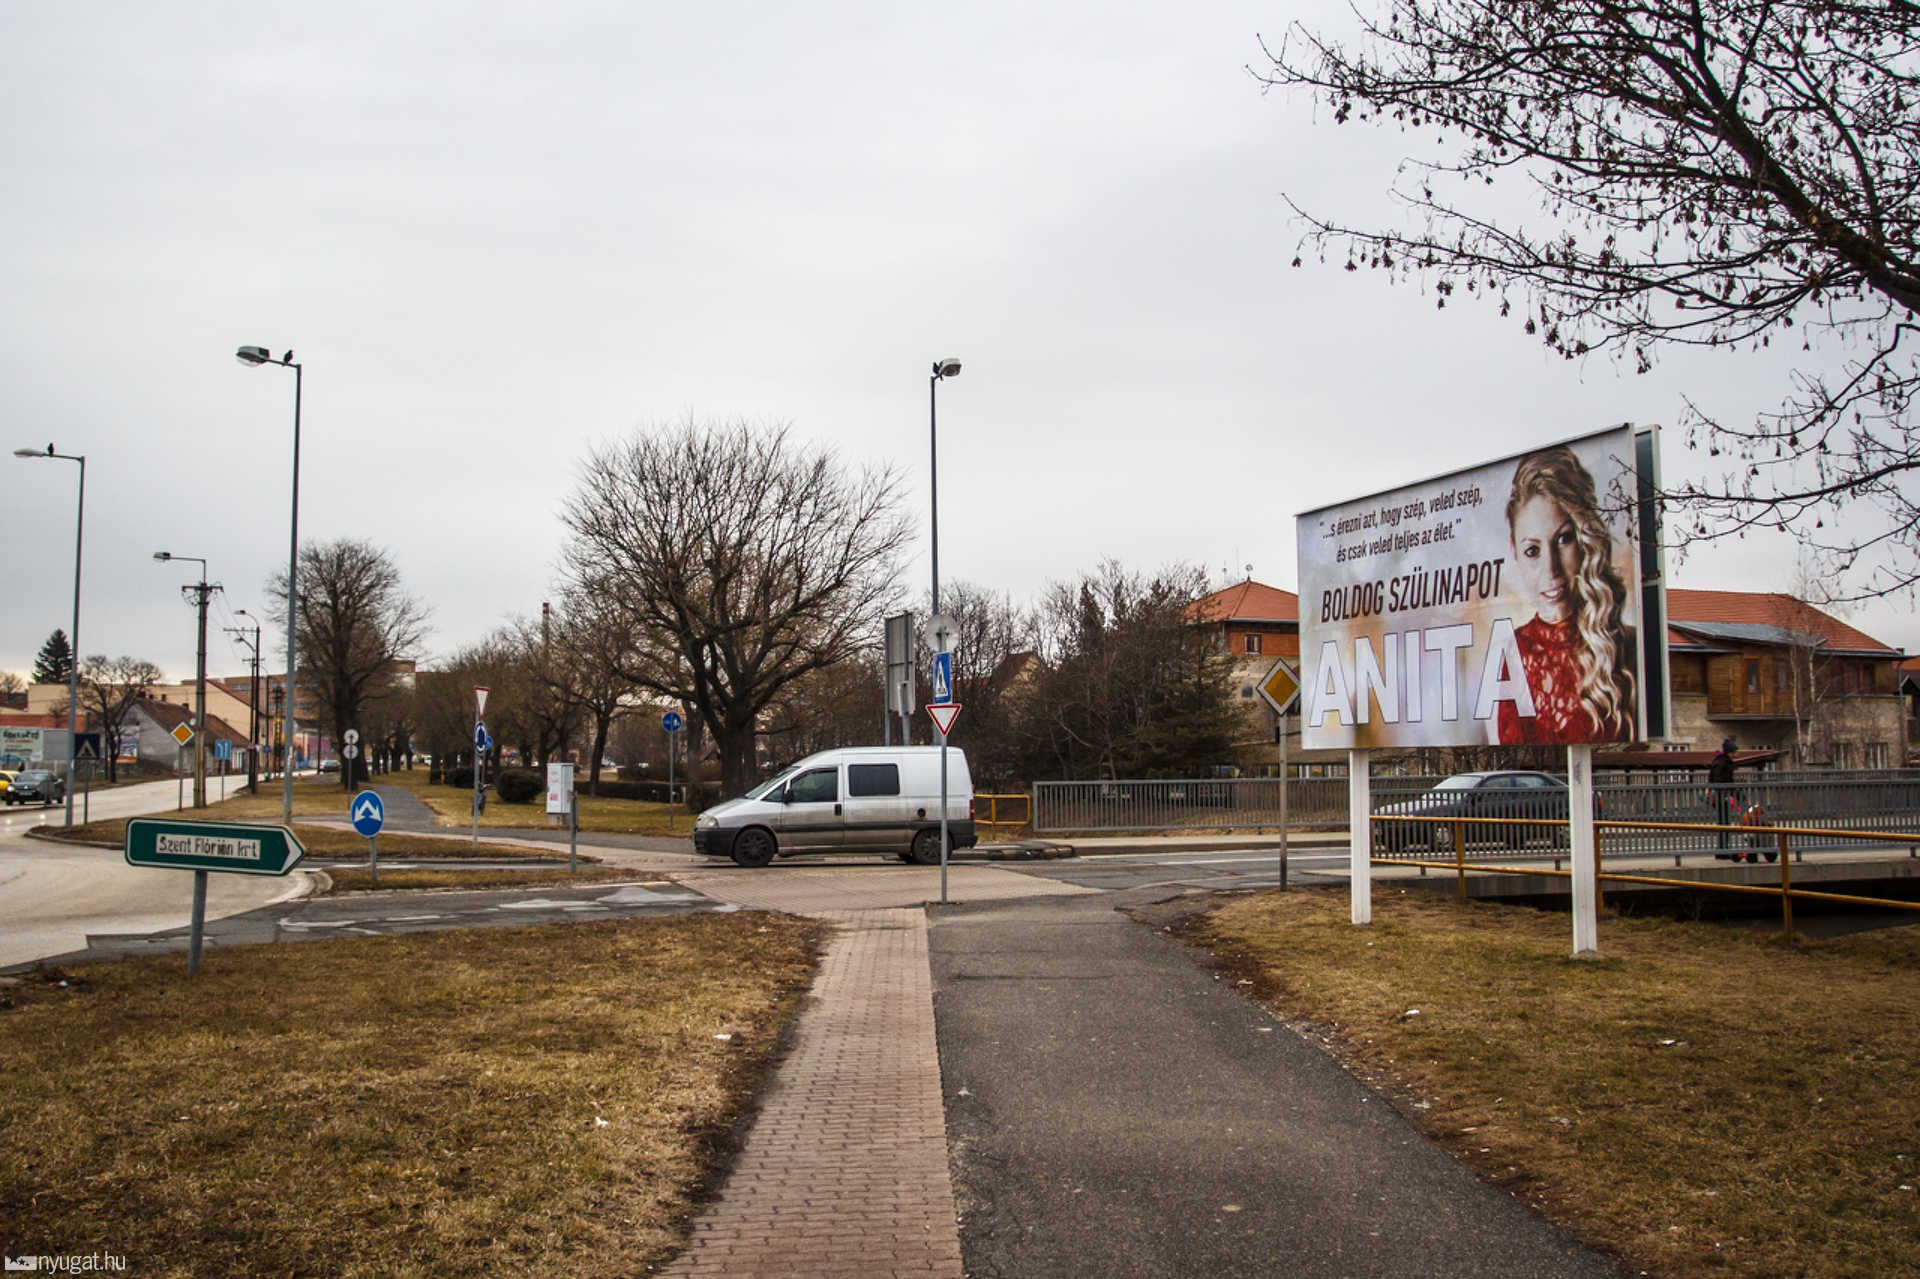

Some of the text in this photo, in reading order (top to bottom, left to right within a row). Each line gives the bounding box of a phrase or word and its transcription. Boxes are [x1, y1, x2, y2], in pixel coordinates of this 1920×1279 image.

[1337, 512, 1362, 536] érezni
[1363, 510, 1378, 529] azt,
[1380, 507, 1402, 527] hogy
[1404, 500, 1426, 521] szép,
[1429, 489, 1456, 513] veled
[1457, 484, 1483, 508] szép,
[1336, 547, 1346, 563] és
[1348, 540, 1367, 560] csak
[1369, 533, 1393, 556] veled
[1394, 530, 1420, 553] teljes
[1422, 530, 1432, 545] az
[1321, 557, 1505, 623] BOLDOG SZÜLINAPOT
[1308, 617, 1537, 728] ANITA
[159, 836, 257, 858] Szent Flórián krt
